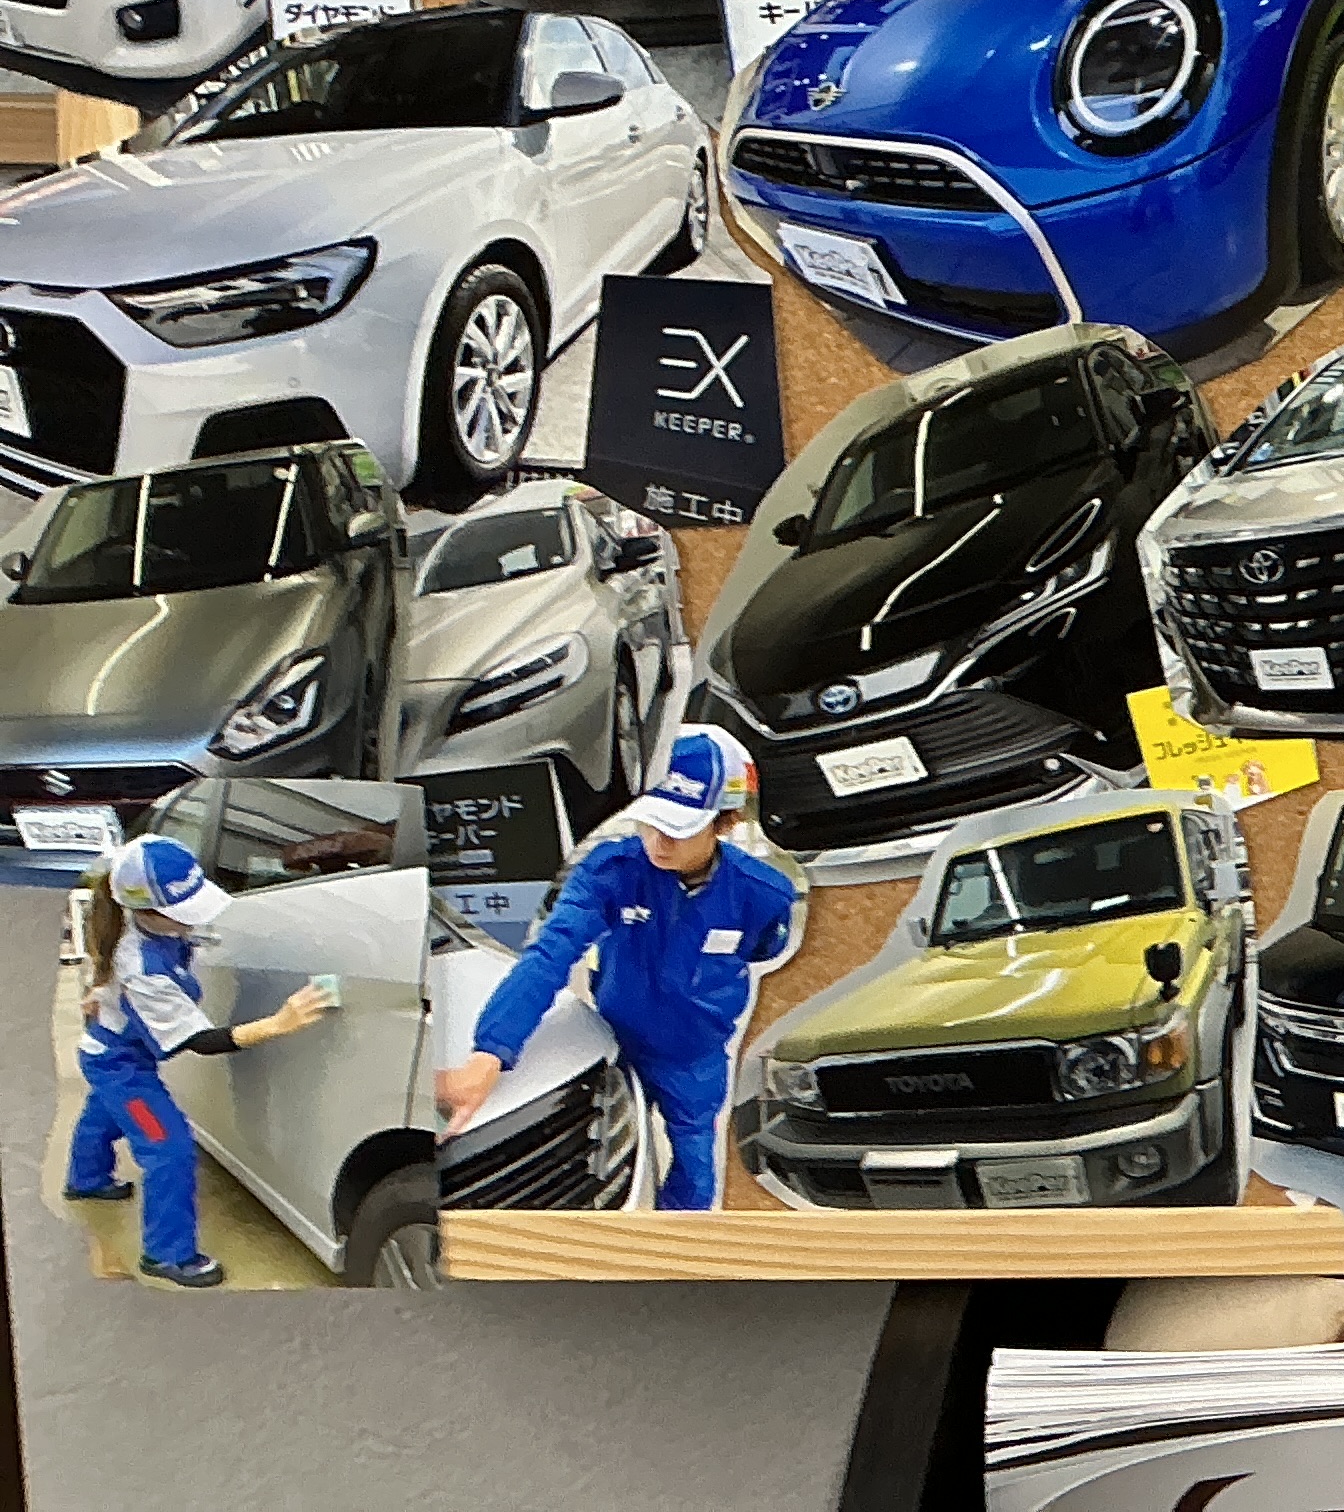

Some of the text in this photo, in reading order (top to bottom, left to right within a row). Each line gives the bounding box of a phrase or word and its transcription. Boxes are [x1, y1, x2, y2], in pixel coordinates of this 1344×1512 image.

[653, 411, 743, 441] KEEPER
[643, 484, 744, 523] 施工中
[885, 1073, 974, 1095] TOYOTA
